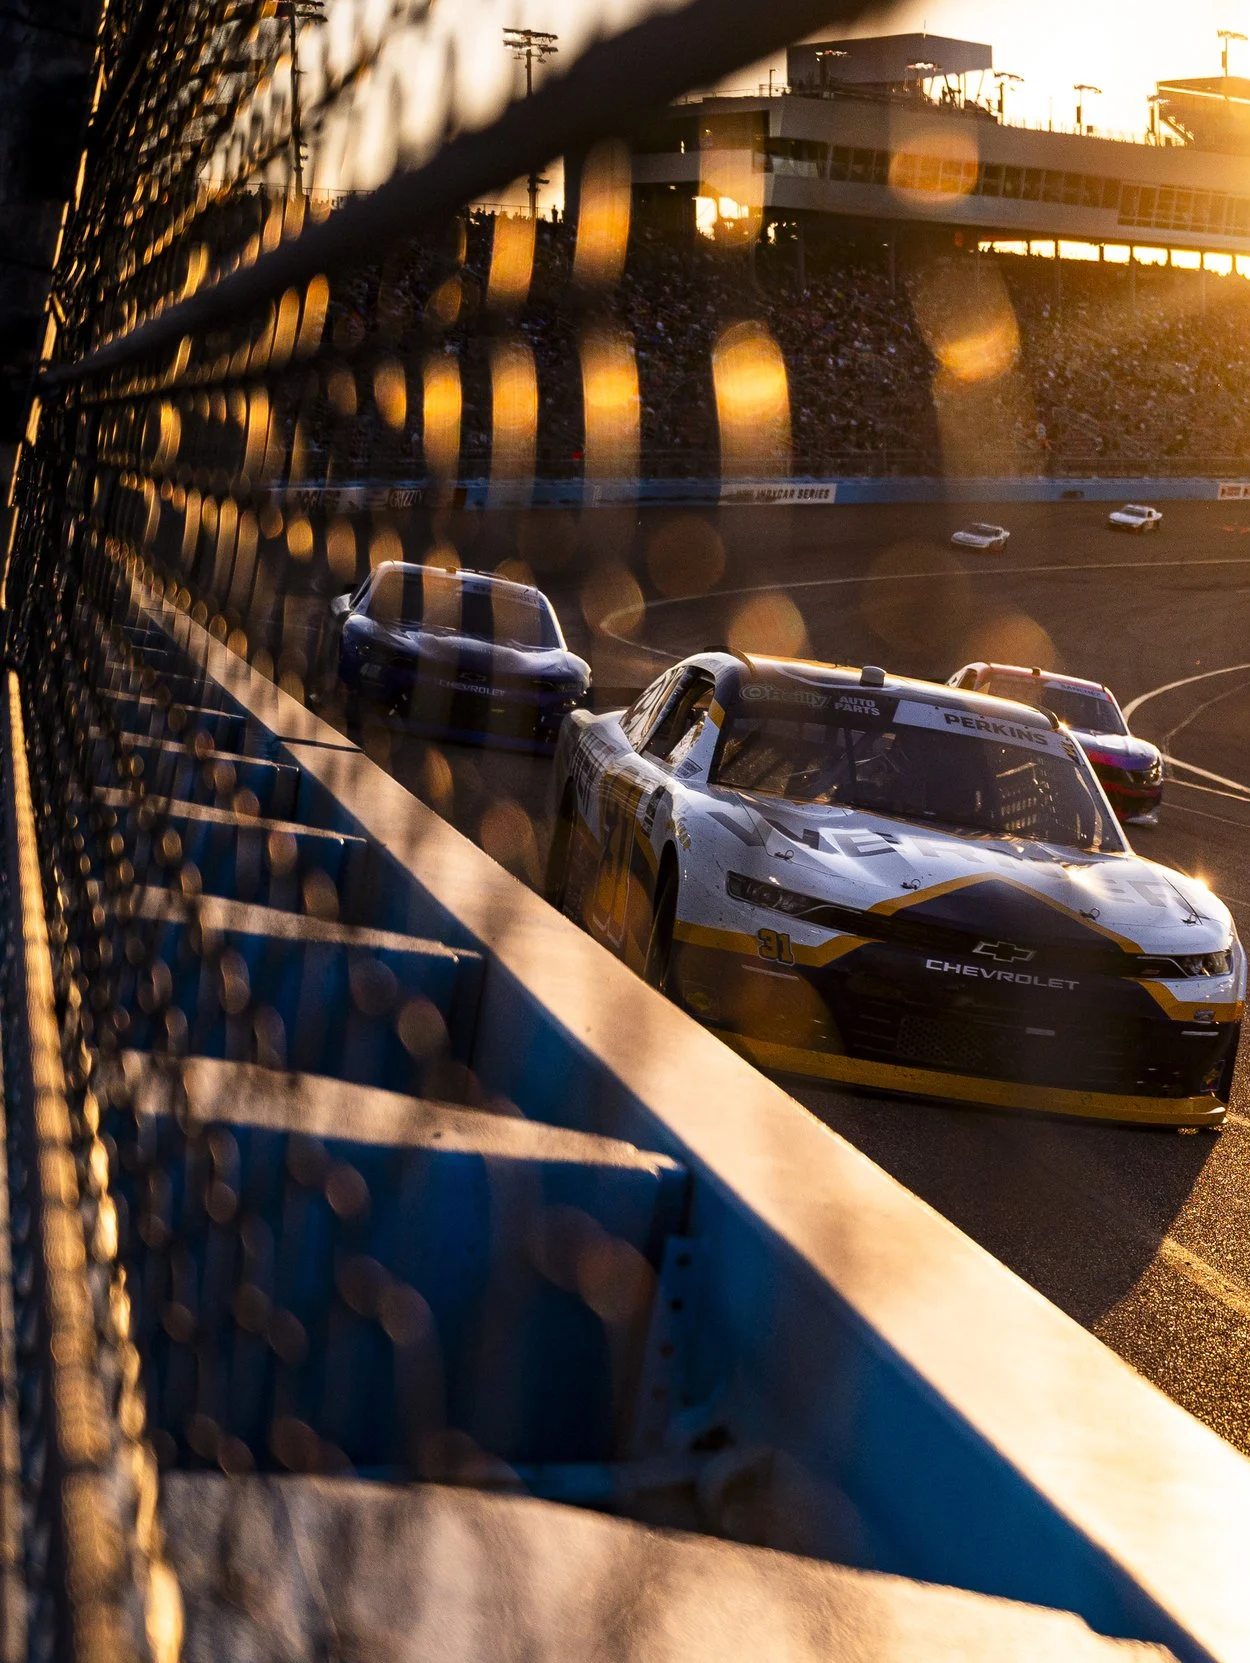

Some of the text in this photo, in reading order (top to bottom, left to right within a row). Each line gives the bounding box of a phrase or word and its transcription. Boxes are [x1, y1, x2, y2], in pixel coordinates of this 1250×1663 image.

[797, 488, 831, 500] SERIES
[834, 702, 881, 716] PARTS
[839, 696, 876, 709] AUTO
[943, 713, 1050, 747] PERKINS
[757, 927, 796, 967] 31
[925, 958, 1081, 991] CHEVROLET
